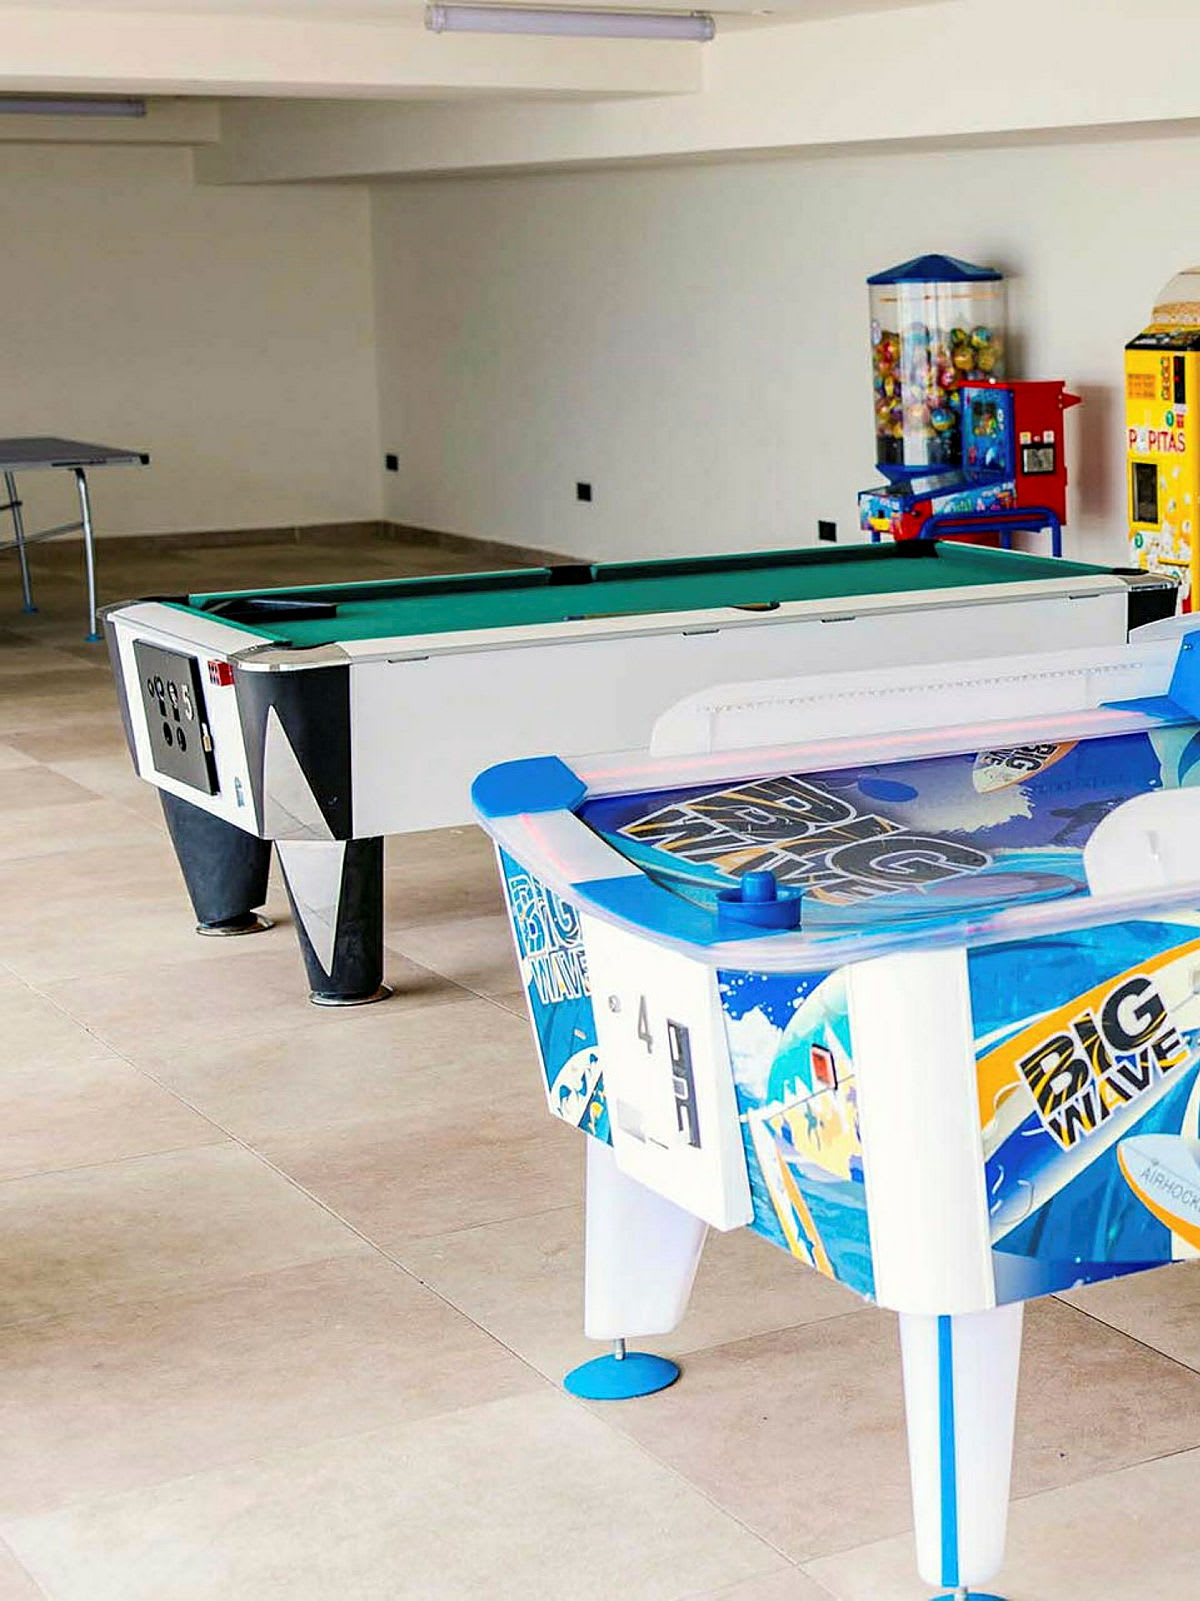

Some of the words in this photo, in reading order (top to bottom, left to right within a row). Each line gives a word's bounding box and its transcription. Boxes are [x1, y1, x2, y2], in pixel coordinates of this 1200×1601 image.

[1128, 428, 1186, 453] PPITAS
[682, 775, 993, 888] BIG
[508, 874, 584, 955] BIG
[637, 995, 653, 1055] 4
[1018, 976, 1170, 1118] BIG
[1047, 1026, 1191, 1147] WAVE
